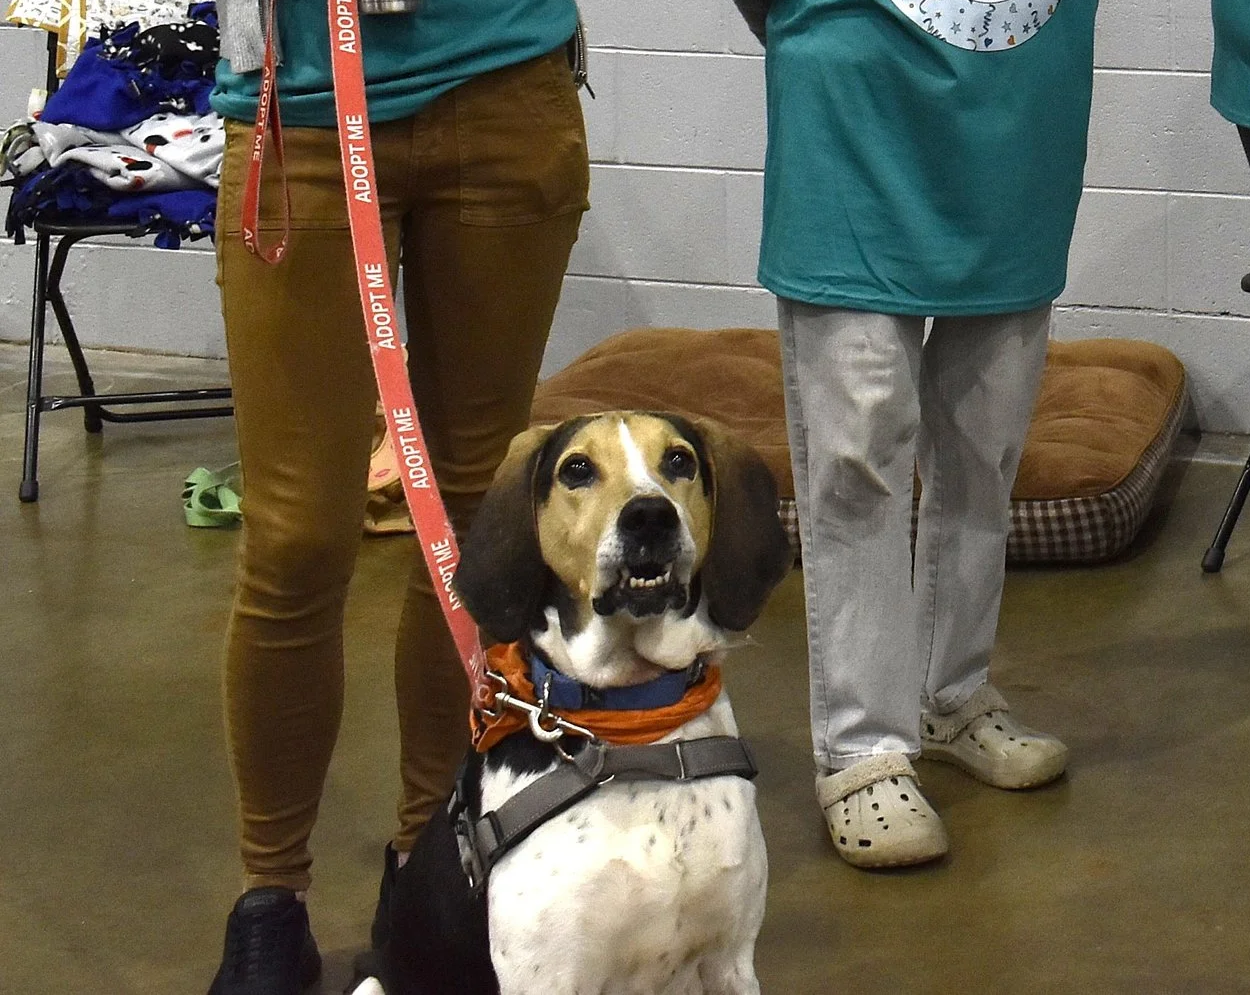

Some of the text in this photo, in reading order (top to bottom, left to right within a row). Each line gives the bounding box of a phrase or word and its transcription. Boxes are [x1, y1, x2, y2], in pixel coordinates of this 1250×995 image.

[252, 65, 272, 162] ADOPT ME
[345, 114, 372, 204] ADOPT ME
[364, 262, 396, 350] ADOPT ME
[392, 406, 431, 490] ADOPT ME
[430, 538, 454, 564] ME
